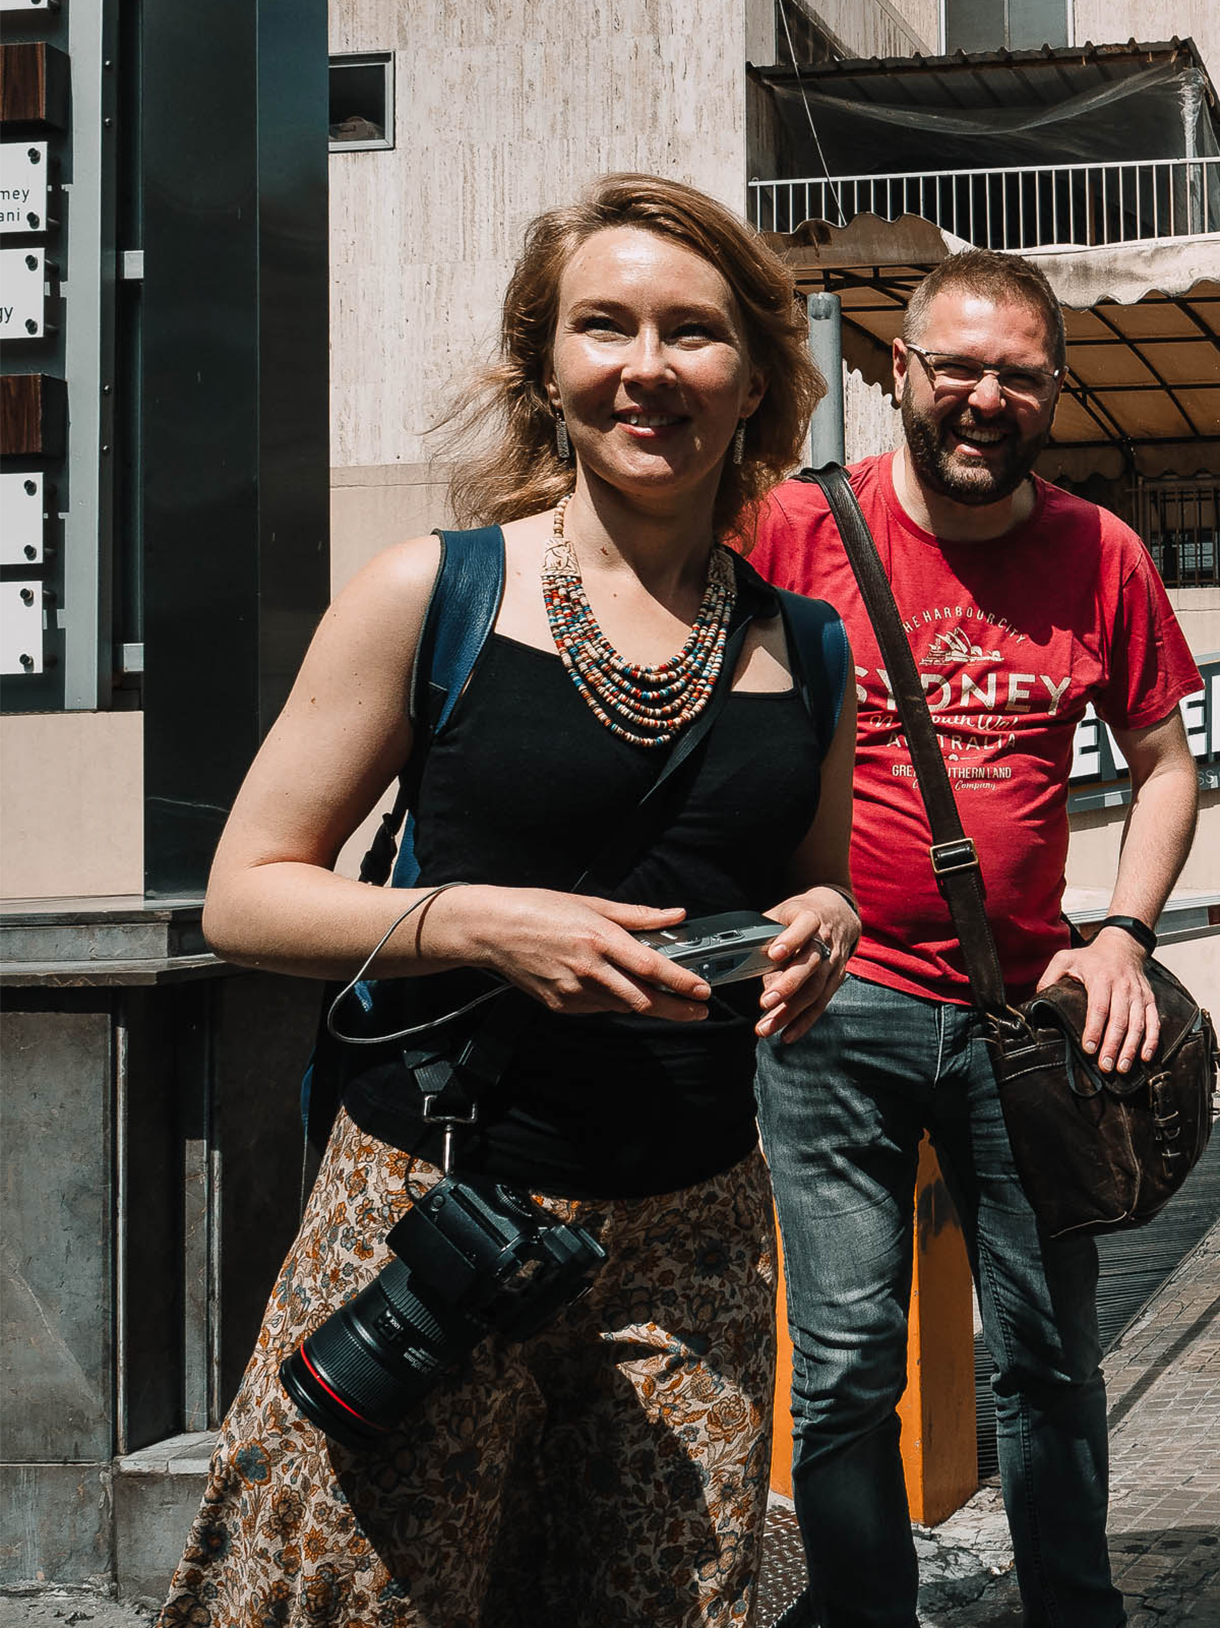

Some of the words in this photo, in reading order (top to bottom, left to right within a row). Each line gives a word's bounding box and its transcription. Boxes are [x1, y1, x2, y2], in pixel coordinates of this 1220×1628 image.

[902, 615, 921, 634] HE
[922, 606, 995, 625] HARBOUR
[997, 617, 1026, 644] CITY
[931, 714, 976, 727] outh
[886, 732, 1016, 751] ATRALIA
[954, 780, 998, 792] Company
